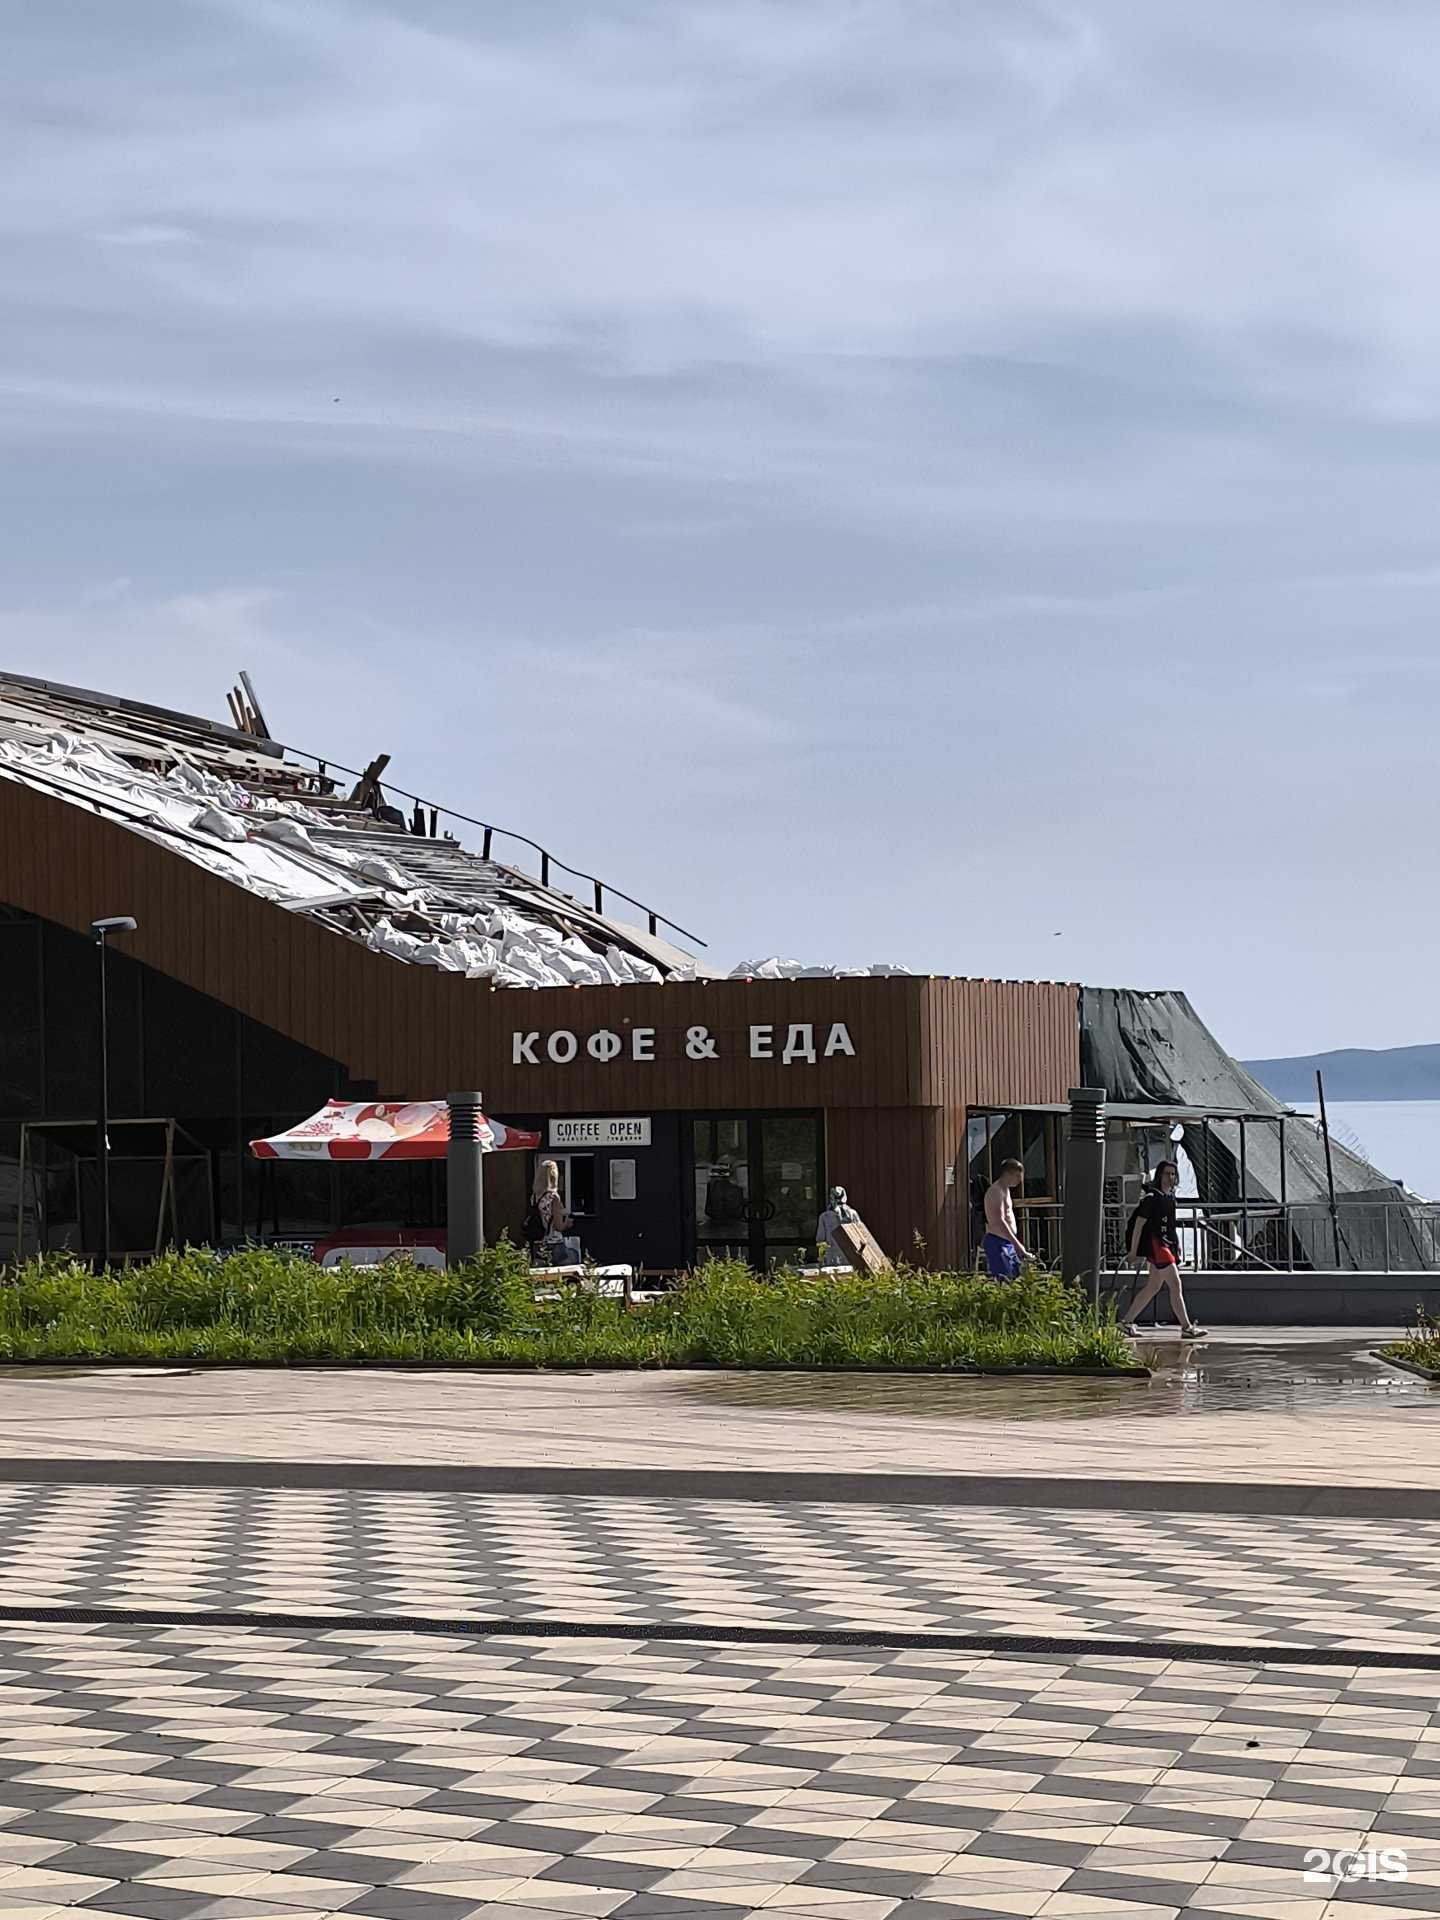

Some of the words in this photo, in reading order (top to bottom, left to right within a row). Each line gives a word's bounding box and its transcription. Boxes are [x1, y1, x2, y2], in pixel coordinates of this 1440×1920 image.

[512, 1027, 656, 1065] КОФЕ
[685, 1025, 720, 1060] &
[750, 1022, 856, 1065] ЕДА
[557, 1123, 600, 1136] COFFEE
[609, 1122, 642, 1136] OPEN
